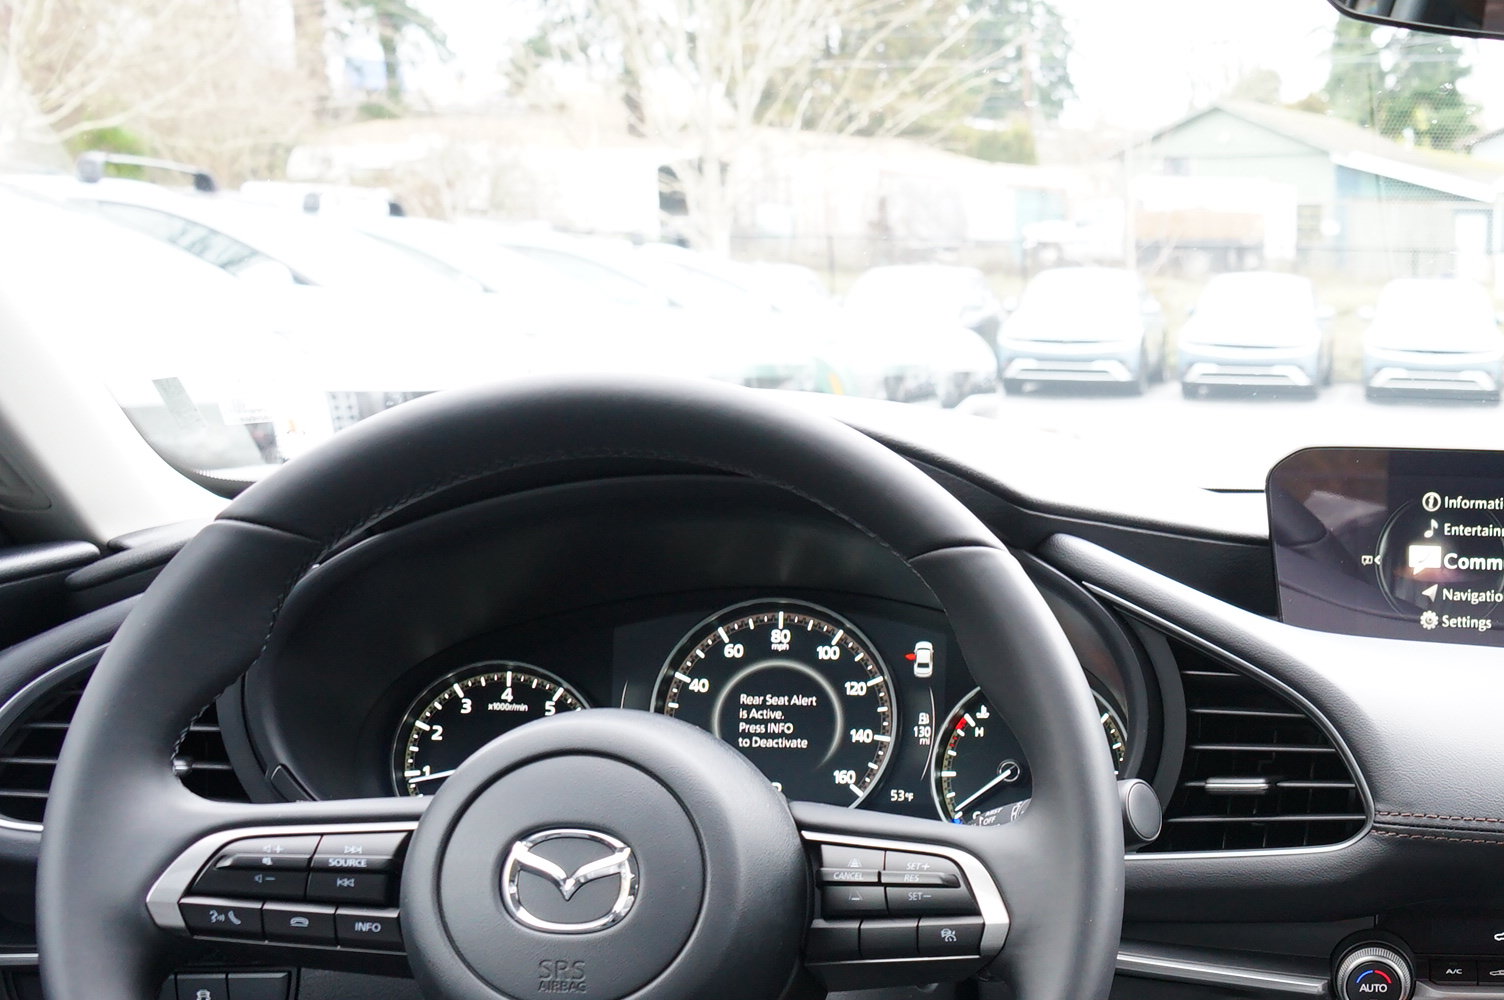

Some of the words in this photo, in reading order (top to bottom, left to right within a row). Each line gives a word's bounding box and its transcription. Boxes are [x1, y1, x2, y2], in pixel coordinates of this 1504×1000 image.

[1441, 616, 1492, 632] Settings
[771, 630, 791, 643] 80
[724, 645, 744, 658] 60
[771, 643, 789, 652] mph
[817, 646, 840, 660] 100
[689, 679, 709, 693] 40
[845, 683, 867, 696] 120
[501, 688, 513, 702] 4
[740, 694, 764, 705] Rear
[766, 694, 789, 706] Seat
[791, 694, 817, 706] Alert
[461, 699, 472, 714] 3
[488, 704, 529, 712] x1000r/min
[545, 702, 556, 716] 5
[739, 708, 748, 719] is
[749, 708, 785, 719] Active.
[431, 726, 443, 740] 2
[739, 722, 766, 733] Press
[768, 722, 794, 734] INFO
[914, 727, 931, 737] 130
[975, 727, 984, 737] H
[738, 737, 750, 747] to
[752, 736, 808, 748] Deactivate
[850, 730, 873, 743] 140
[422, 766, 431, 777] 1
[834, 771, 856, 784] 160
[983, 816, 997, 825] OFF
[328, 858, 367, 867] SOURCE
[834, 872, 864, 880] CANCEL
[904, 874, 919, 882] RES
[355, 922, 381, 932] INFO
[538, 959, 586, 981] SRS
[538, 981, 587, 993] AIRBAG
[1359, 984, 1388, 992] AUTO
